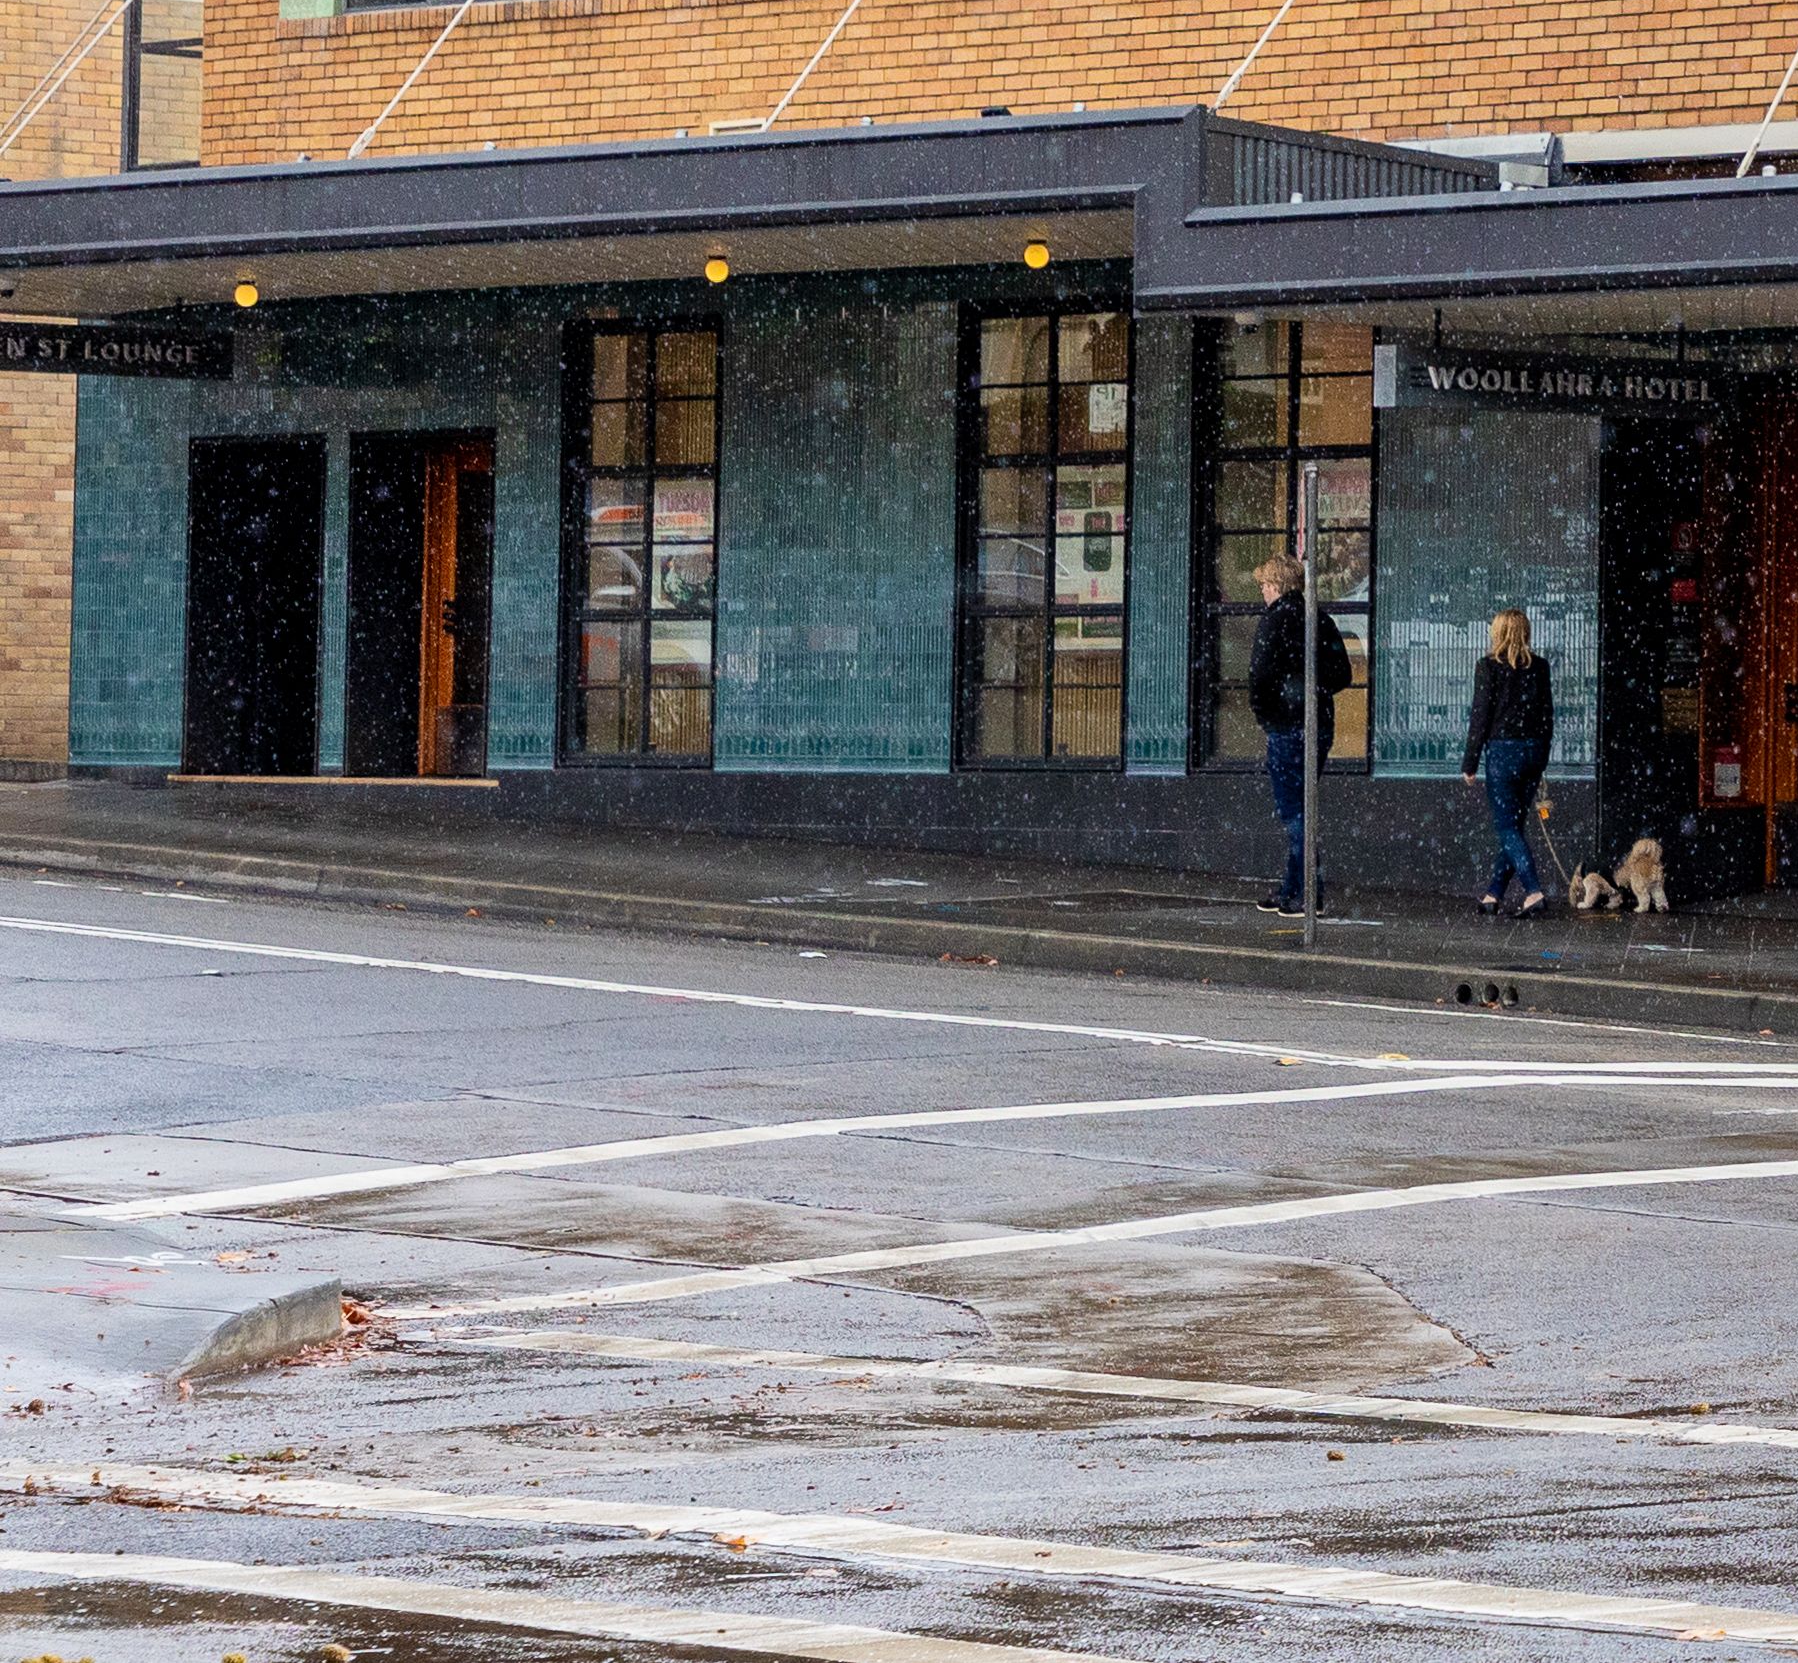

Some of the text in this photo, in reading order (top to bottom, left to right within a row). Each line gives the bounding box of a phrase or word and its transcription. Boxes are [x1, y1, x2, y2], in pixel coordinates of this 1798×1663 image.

[38, 337, 72, 360] ST
[83, 340, 200, 363] LOUNGE
[1427, 365, 1714, 402] WOOLLAHRA HOTEL
